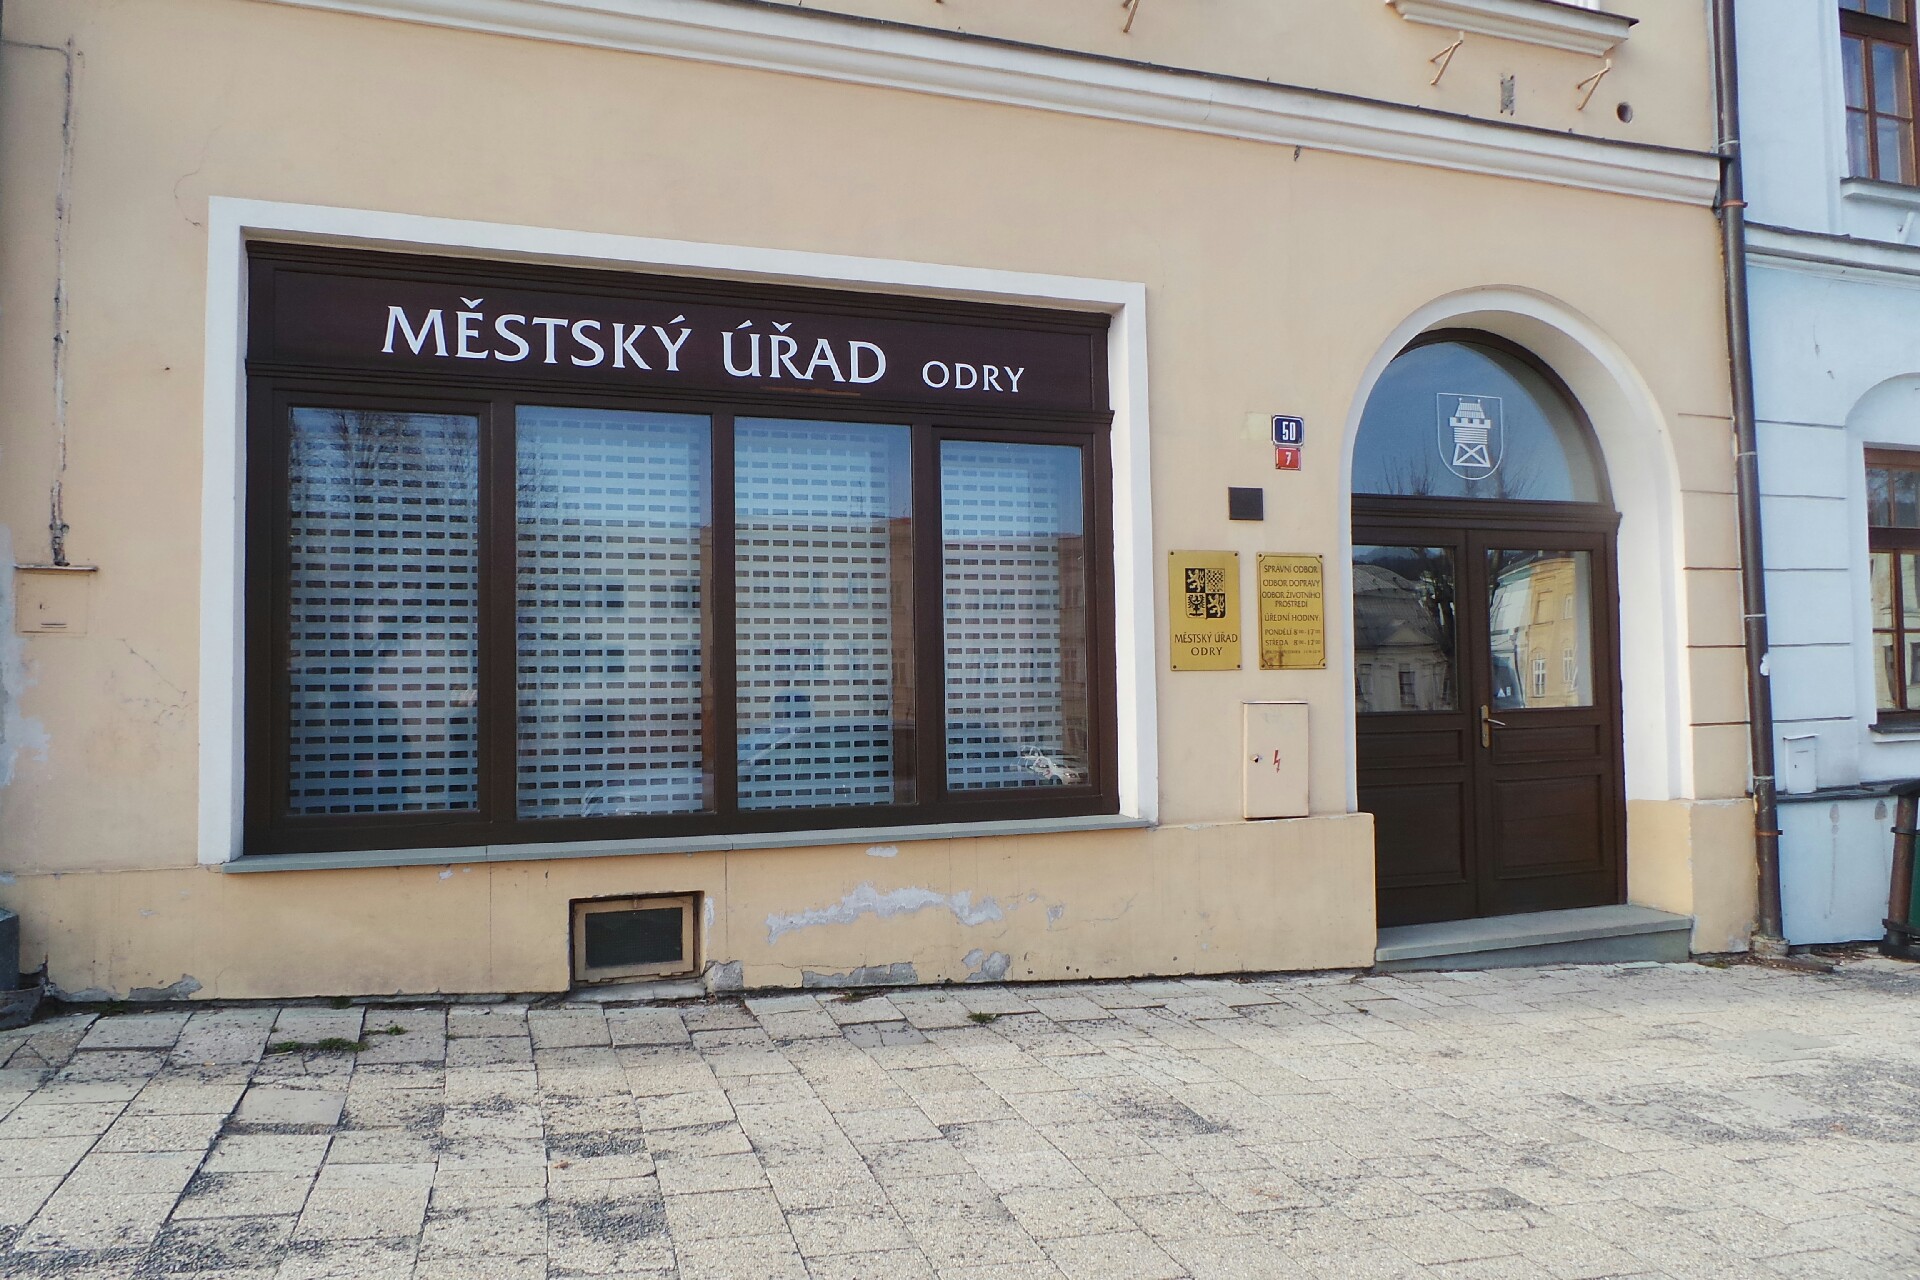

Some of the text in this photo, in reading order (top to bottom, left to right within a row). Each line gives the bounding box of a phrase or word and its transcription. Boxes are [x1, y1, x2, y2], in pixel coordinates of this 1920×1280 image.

[381, 296, 1025, 393] MĚSTSKÝ ÚŘAD ODRY
[1282, 421, 1296, 441] 50
[1285, 451, 1292, 465] 7
[1263, 563, 1318, 573] SPRÁVNÍ ODBOR
[1262, 579, 1320, 587] ODBOR DOPRAVY
[1261, 591, 1285, 599] ODBOR
[1264, 612, 1290, 622] ÚŘEDNÍ
[1264, 627, 1292, 636] PONDĚLÍ
[1174, 631, 1238, 643] MĚSTSKÝ ÚŘAD
[1265, 637, 1289, 646] STŘEDA
[1190, 646, 1223, 656] ODRY
